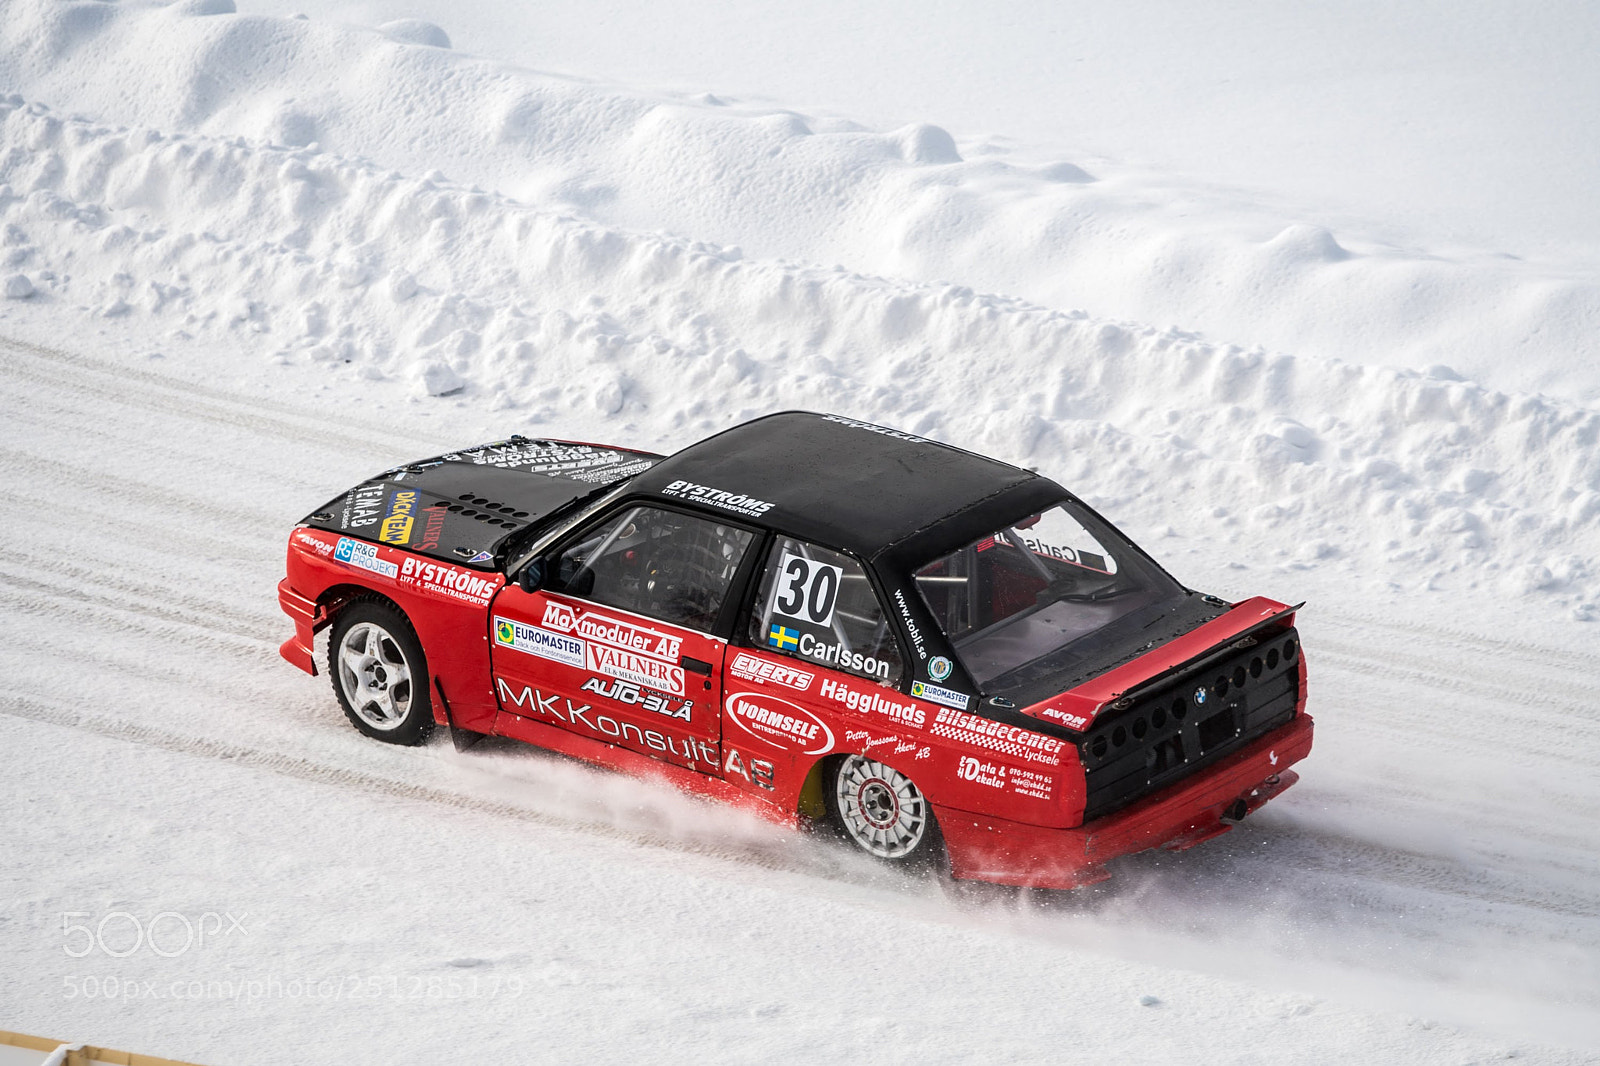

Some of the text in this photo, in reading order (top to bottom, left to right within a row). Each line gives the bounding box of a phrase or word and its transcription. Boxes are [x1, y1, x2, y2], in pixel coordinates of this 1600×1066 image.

[351, 483, 384, 528] TEMAB
[666, 480, 776, 512] BYSTRÖMS
[688, 495, 762, 518] SPECIALTRANSPORTER
[301, 536, 334, 553] AVON
[412, 506, 448, 551] VALLNERS
[352, 553, 398, 576] PROJEKT
[354, 544, 375, 557] R&G
[400, 575, 415, 585] LYFT
[424, 582, 490, 607] SPECIALTRANSPORTER
[401, 557, 498, 599] BYSTRÖMS
[778, 558, 837, 623] 30
[515, 626, 582, 655] EUROMASTER
[894, 589, 927, 660] www.tobli.se
[655, 639, 682, 659] AB
[799, 633, 889, 678] Carlsson
[589, 644, 684, 693] VALLNERS
[619, 670, 657, 688] MEKANISKA
[731, 670, 754, 681] MOTOR
[732, 654, 812, 689] EVERTS
[820, 679, 926, 724] Hägglunds
[924, 686, 967, 703] EUROMASTER
[737, 700, 819, 739] VORMSELE
[1042, 708, 1087, 725] AVON
[845, 730, 868, 742] Petter
[915, 747, 931, 760] AB
[1024, 748, 1060, 766] Lycksele
[724, 748, 775, 792] AB
